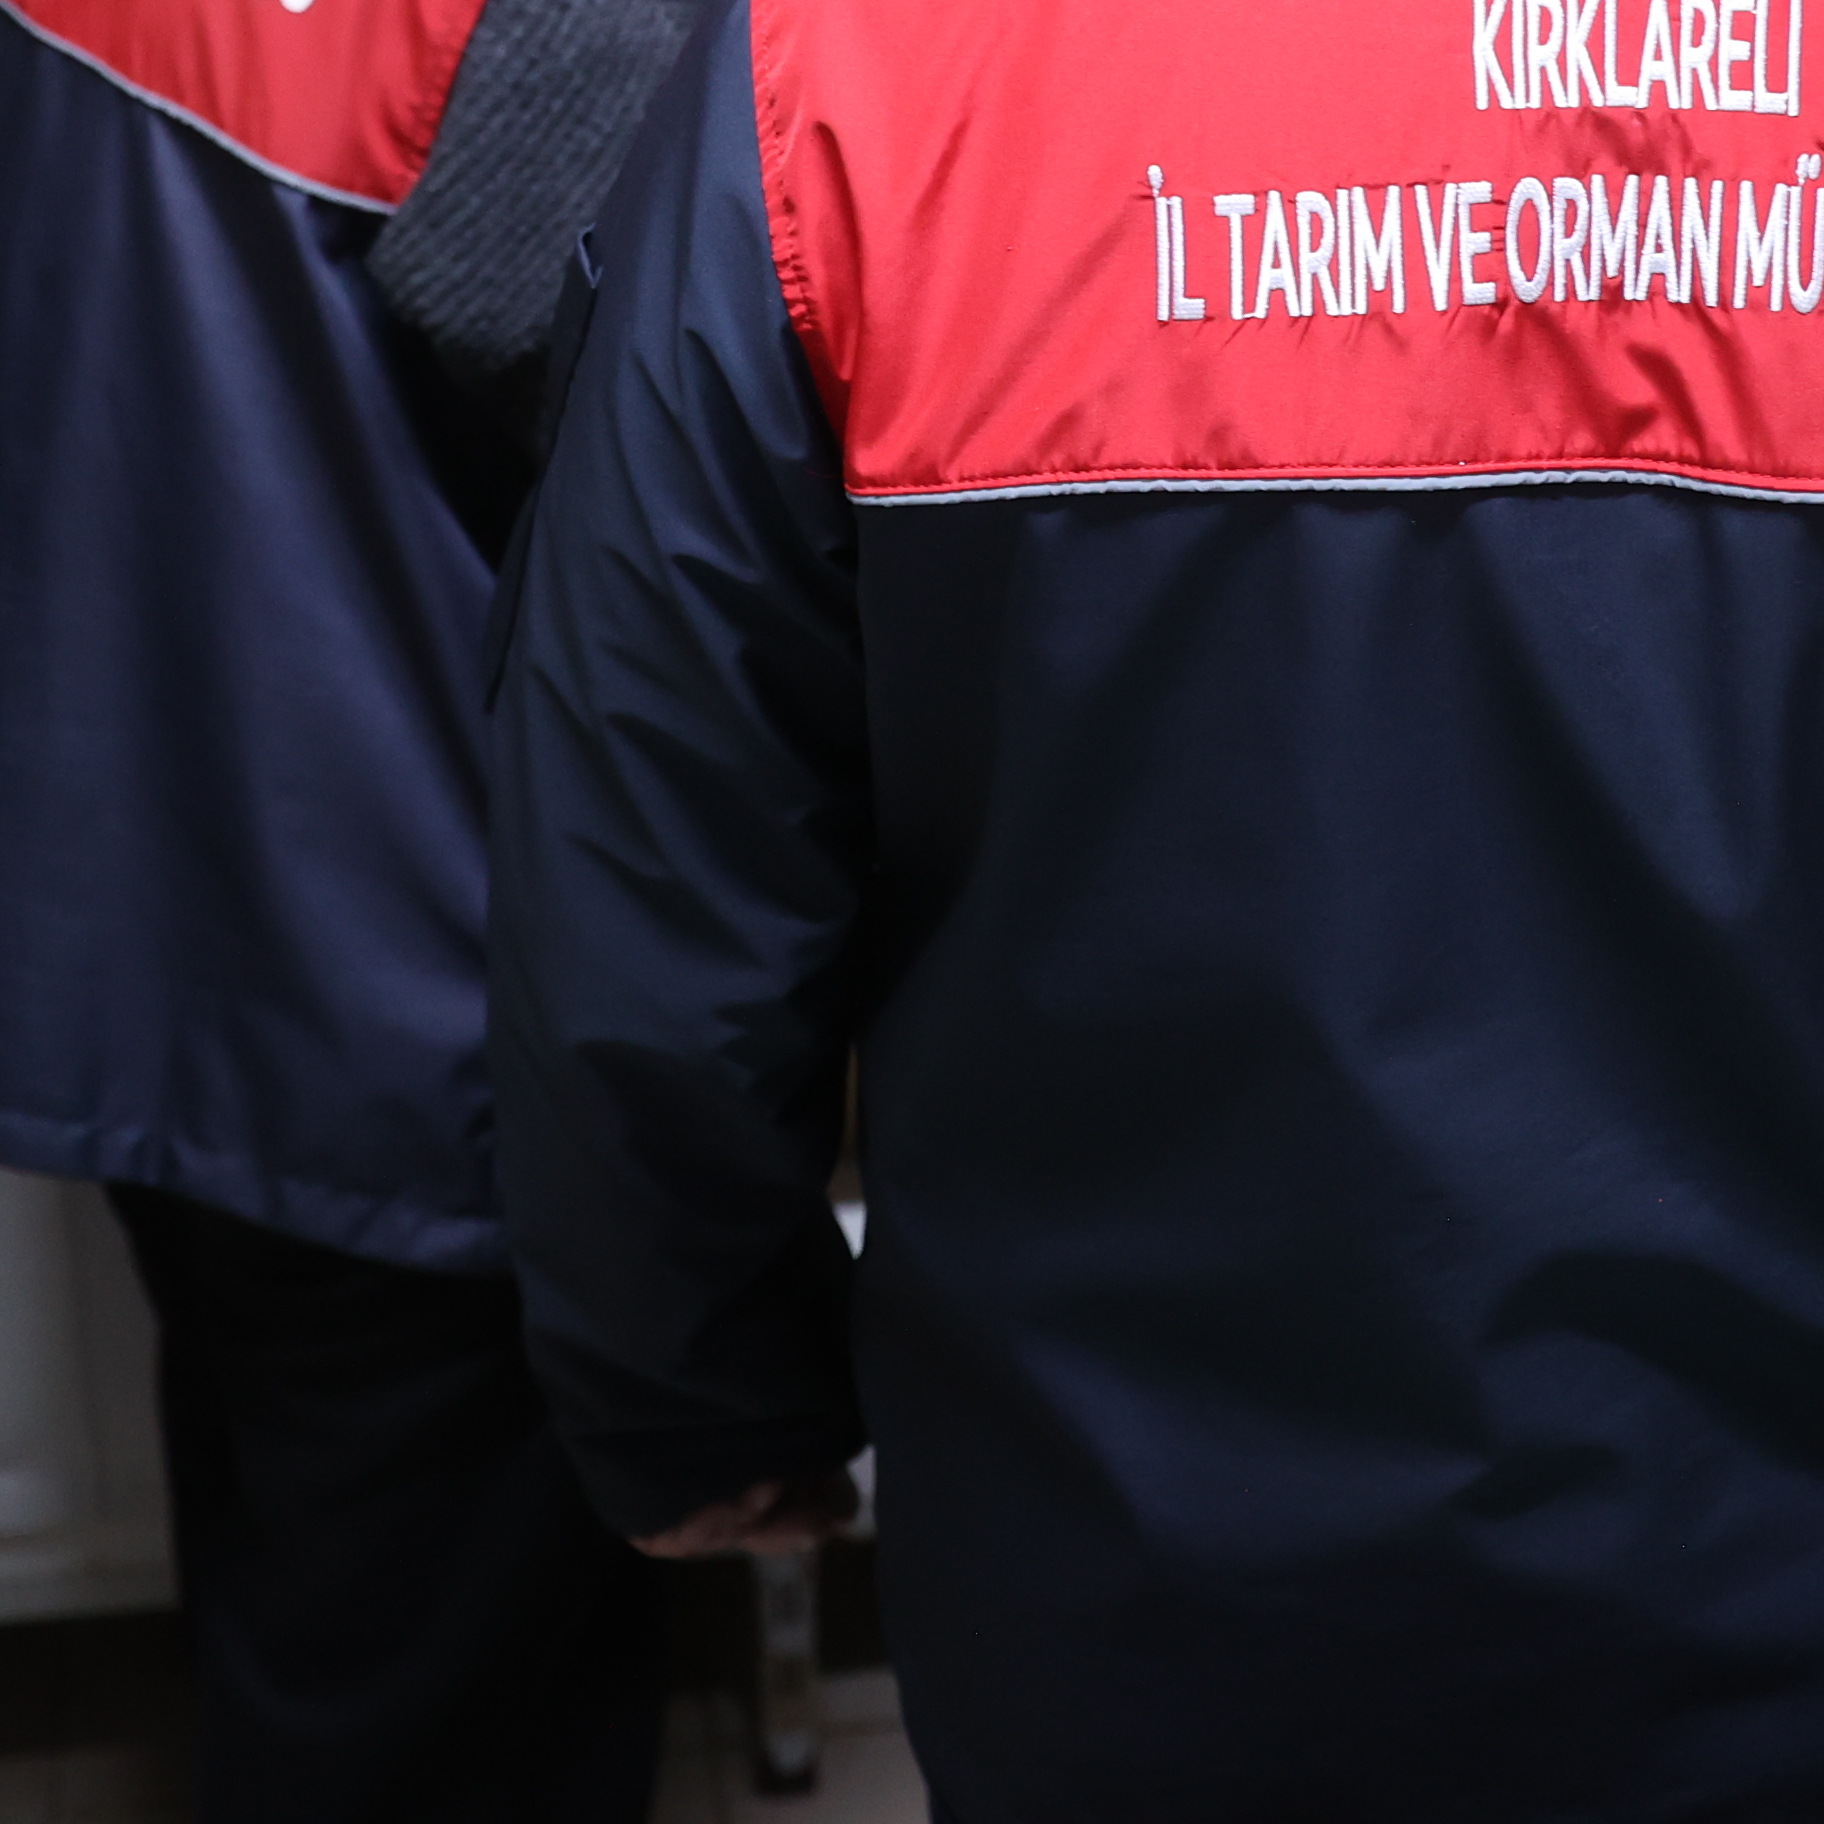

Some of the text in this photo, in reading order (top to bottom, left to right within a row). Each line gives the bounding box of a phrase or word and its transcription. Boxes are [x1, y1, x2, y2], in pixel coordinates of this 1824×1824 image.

[1146, 163, 1206, 322] İL
[1212, 182, 1405, 321] TARIM
[1414, 179, 1498, 313] VE
[1505, 172, 1725, 308] ORMAN
